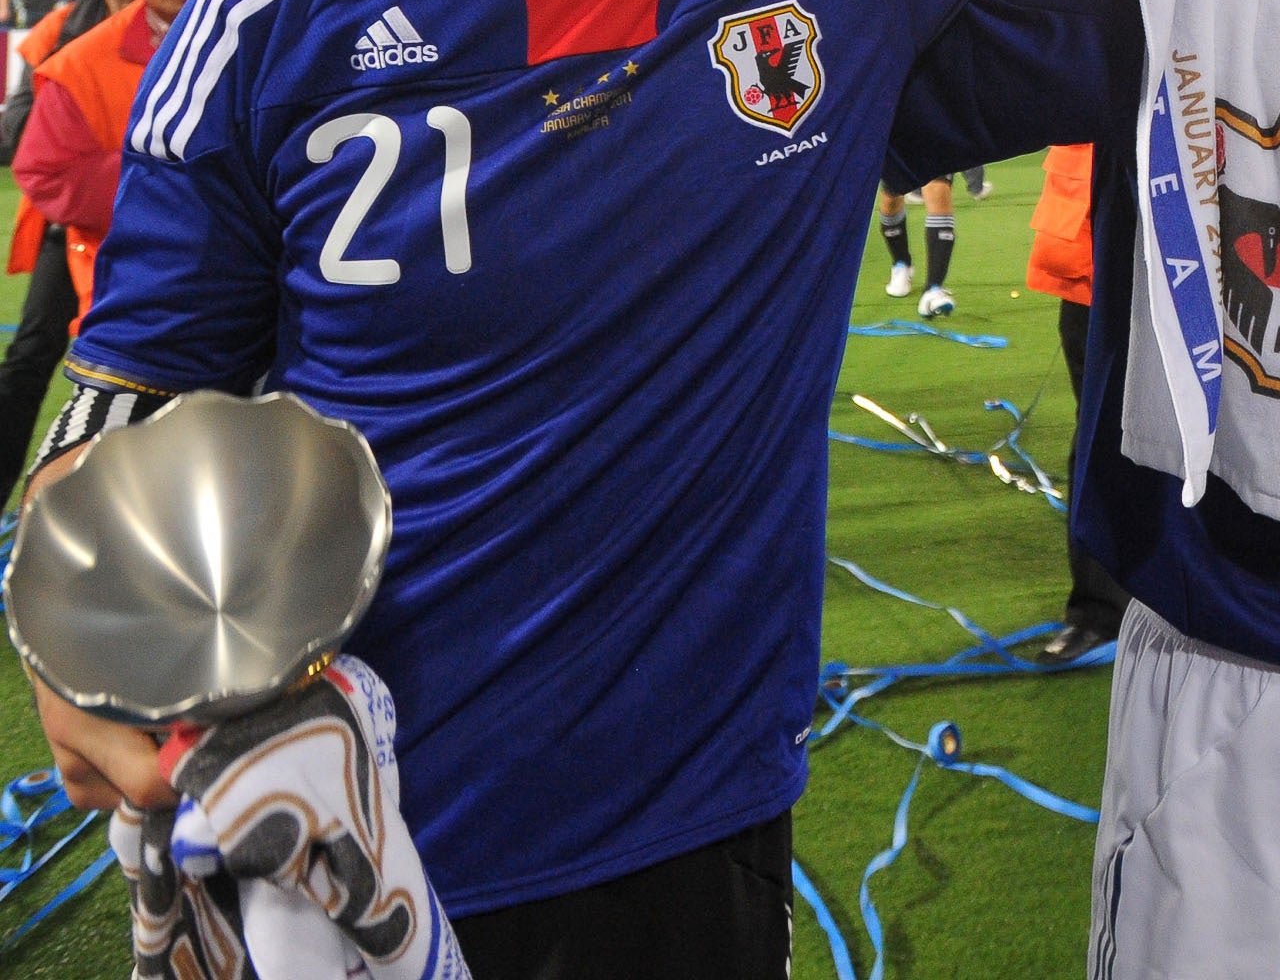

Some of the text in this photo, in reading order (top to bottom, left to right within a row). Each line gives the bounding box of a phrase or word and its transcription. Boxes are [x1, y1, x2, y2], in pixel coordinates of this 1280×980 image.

[732, 18, 801, 52] JFA
[350, 42, 439, 71] adidas
[1171, 49, 1220, 206] JANUARY
[754, 131, 829, 167] JAPAN
[305, 105, 472, 286] 21
